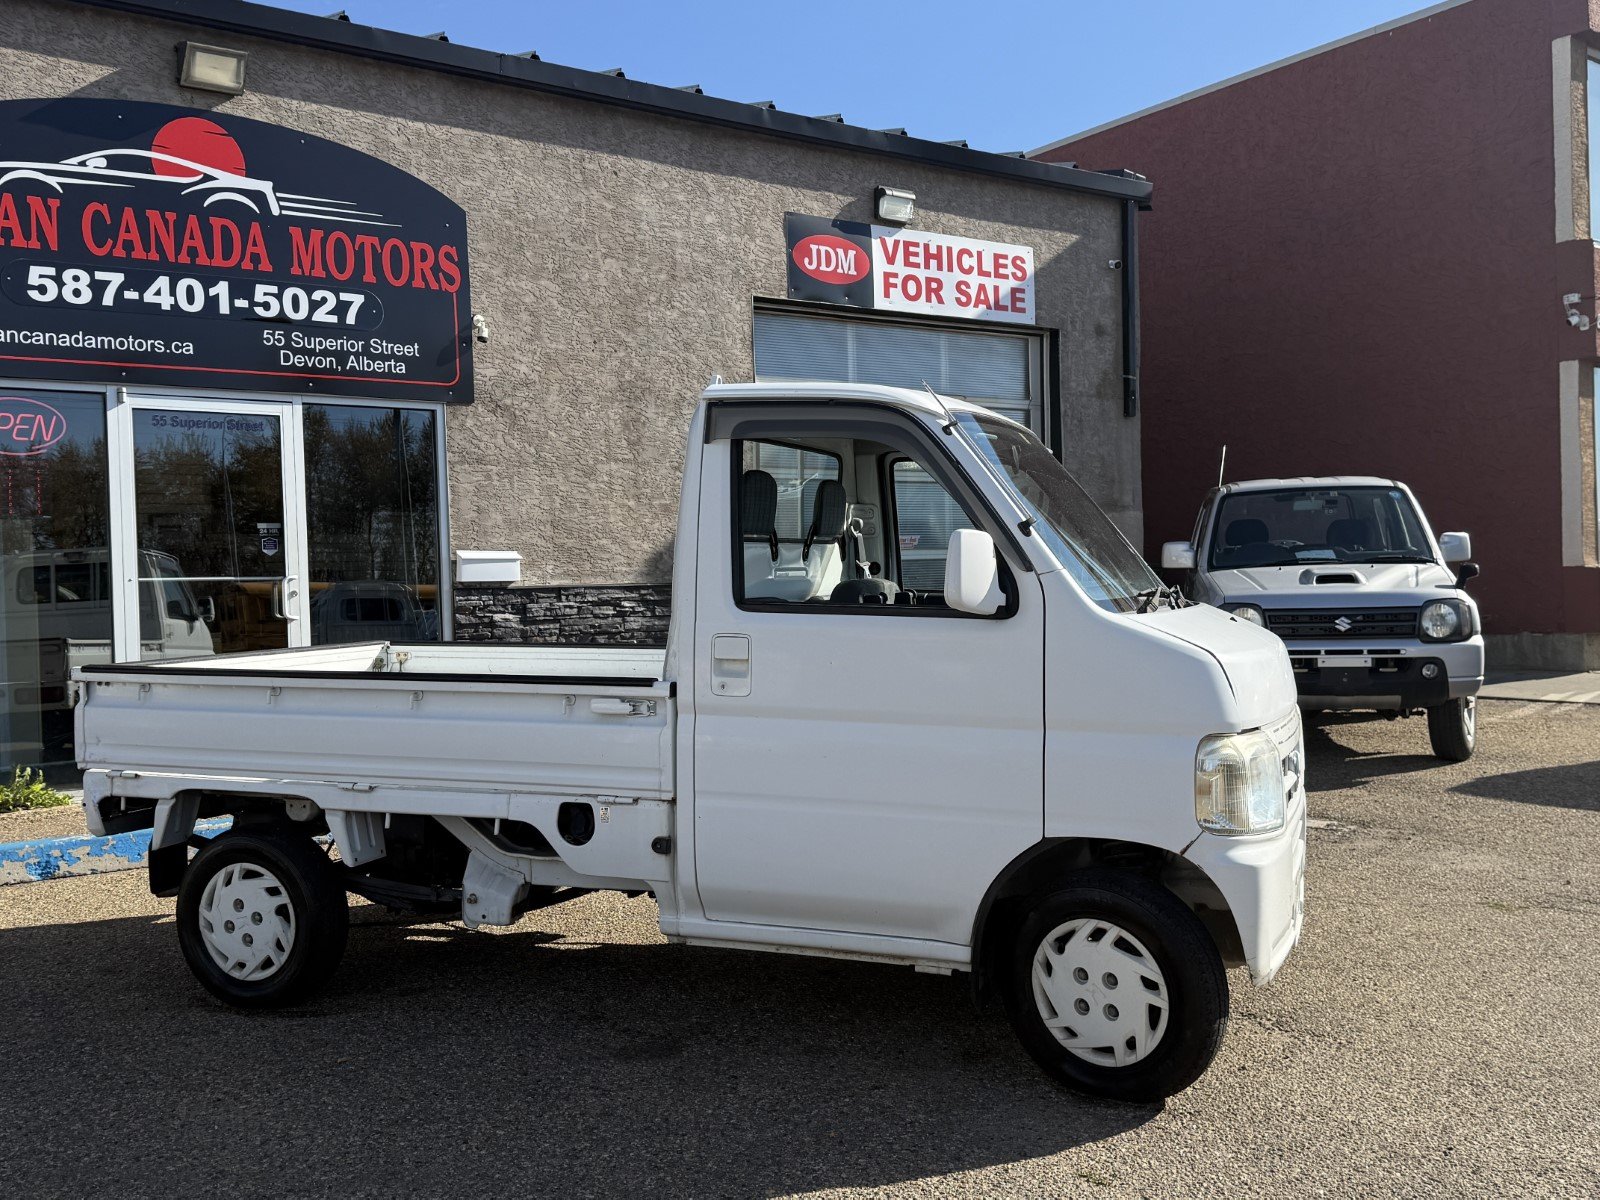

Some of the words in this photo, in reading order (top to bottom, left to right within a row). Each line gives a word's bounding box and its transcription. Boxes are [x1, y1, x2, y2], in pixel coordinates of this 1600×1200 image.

[81, 201, 273, 272] CANADA
[288, 226, 462, 293] MOTORS
[803, 243, 857, 276] JDM
[879, 236, 1027, 282] VEHICLES
[26, 265, 365, 326] 587-401-5027
[883, 271, 945, 305] FOR
[955, 279, 1027, 313] SALE
[263, 329, 285, 346] 55
[291, 331, 365, 352] Superior
[370, 338, 420, 357] Street
[280, 350, 342, 371] Devon,
[346, 355, 406, 373] Alberta
[151, 414, 167, 427] 55
[169, 415, 225, 430] Superior
[226, 418, 264, 432] Street
